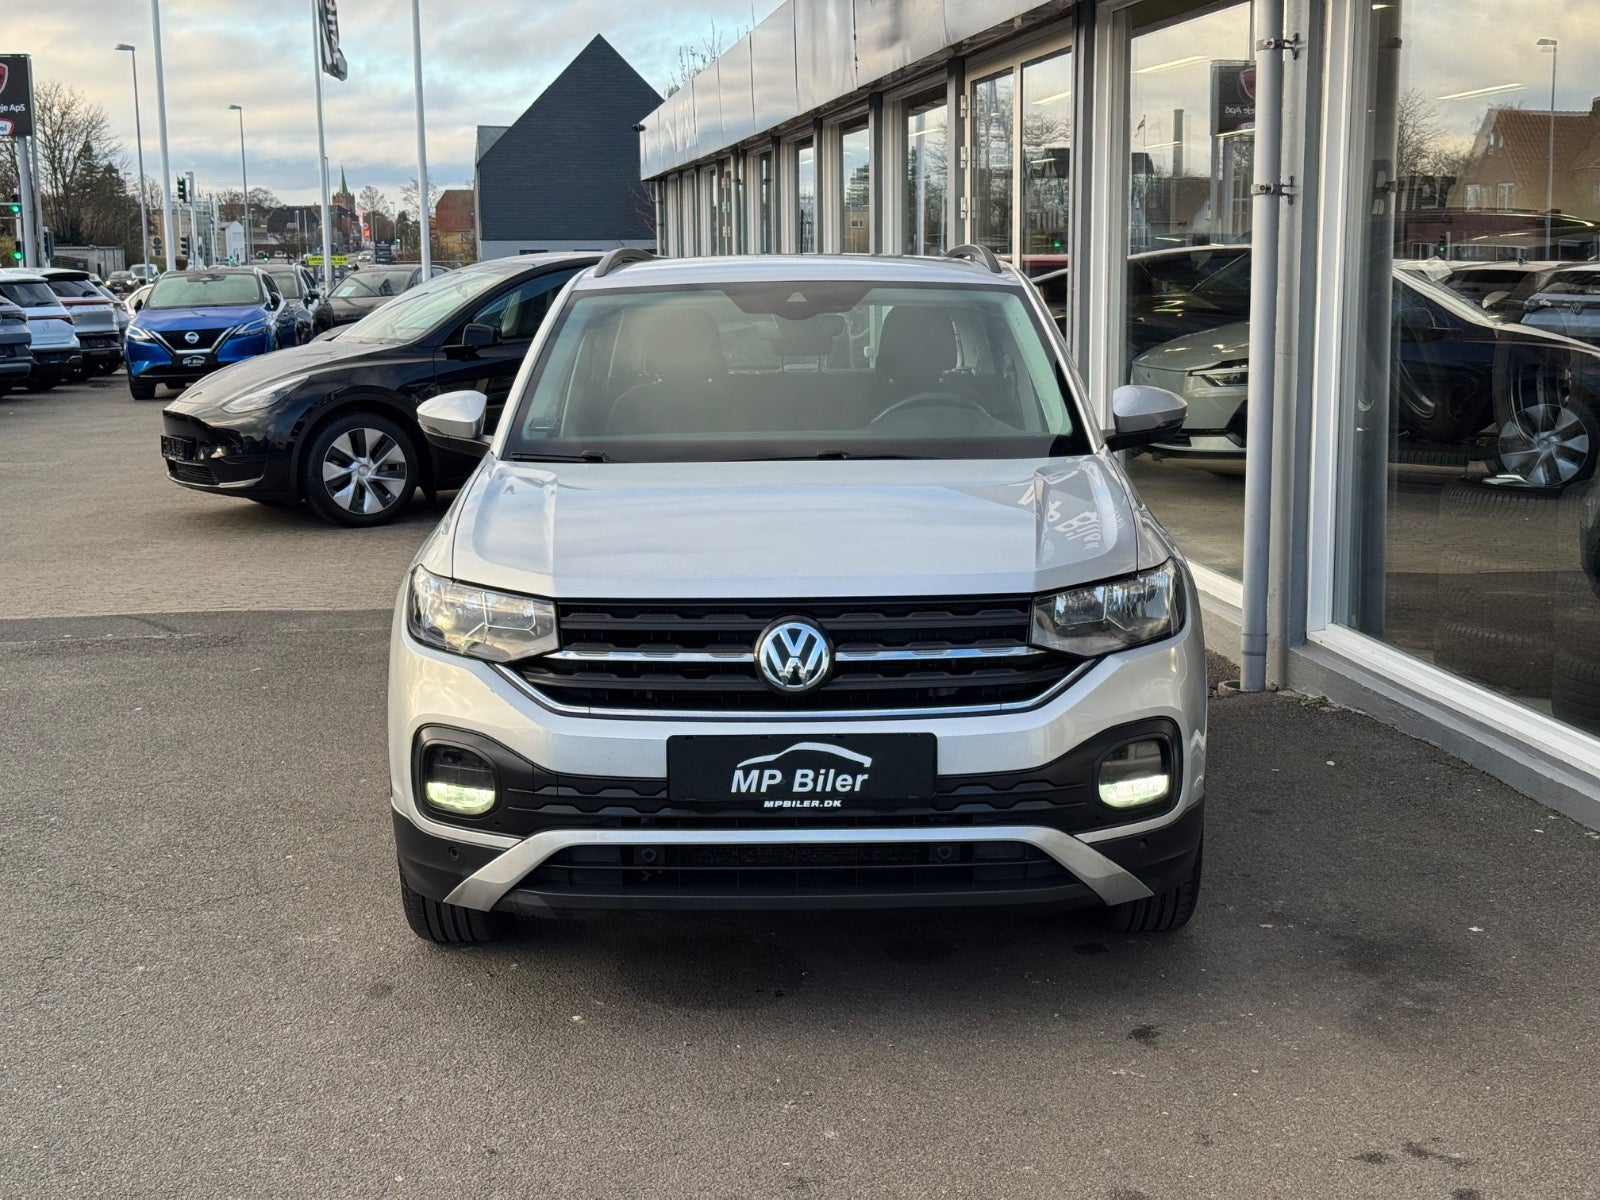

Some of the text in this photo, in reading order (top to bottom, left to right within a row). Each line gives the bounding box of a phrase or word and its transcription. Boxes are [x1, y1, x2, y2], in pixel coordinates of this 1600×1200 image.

[0, 104, 26, 113] je ApS
[731, 768, 869, 793] MP Biler
[763, 800, 842, 808] MPBILER.DK
